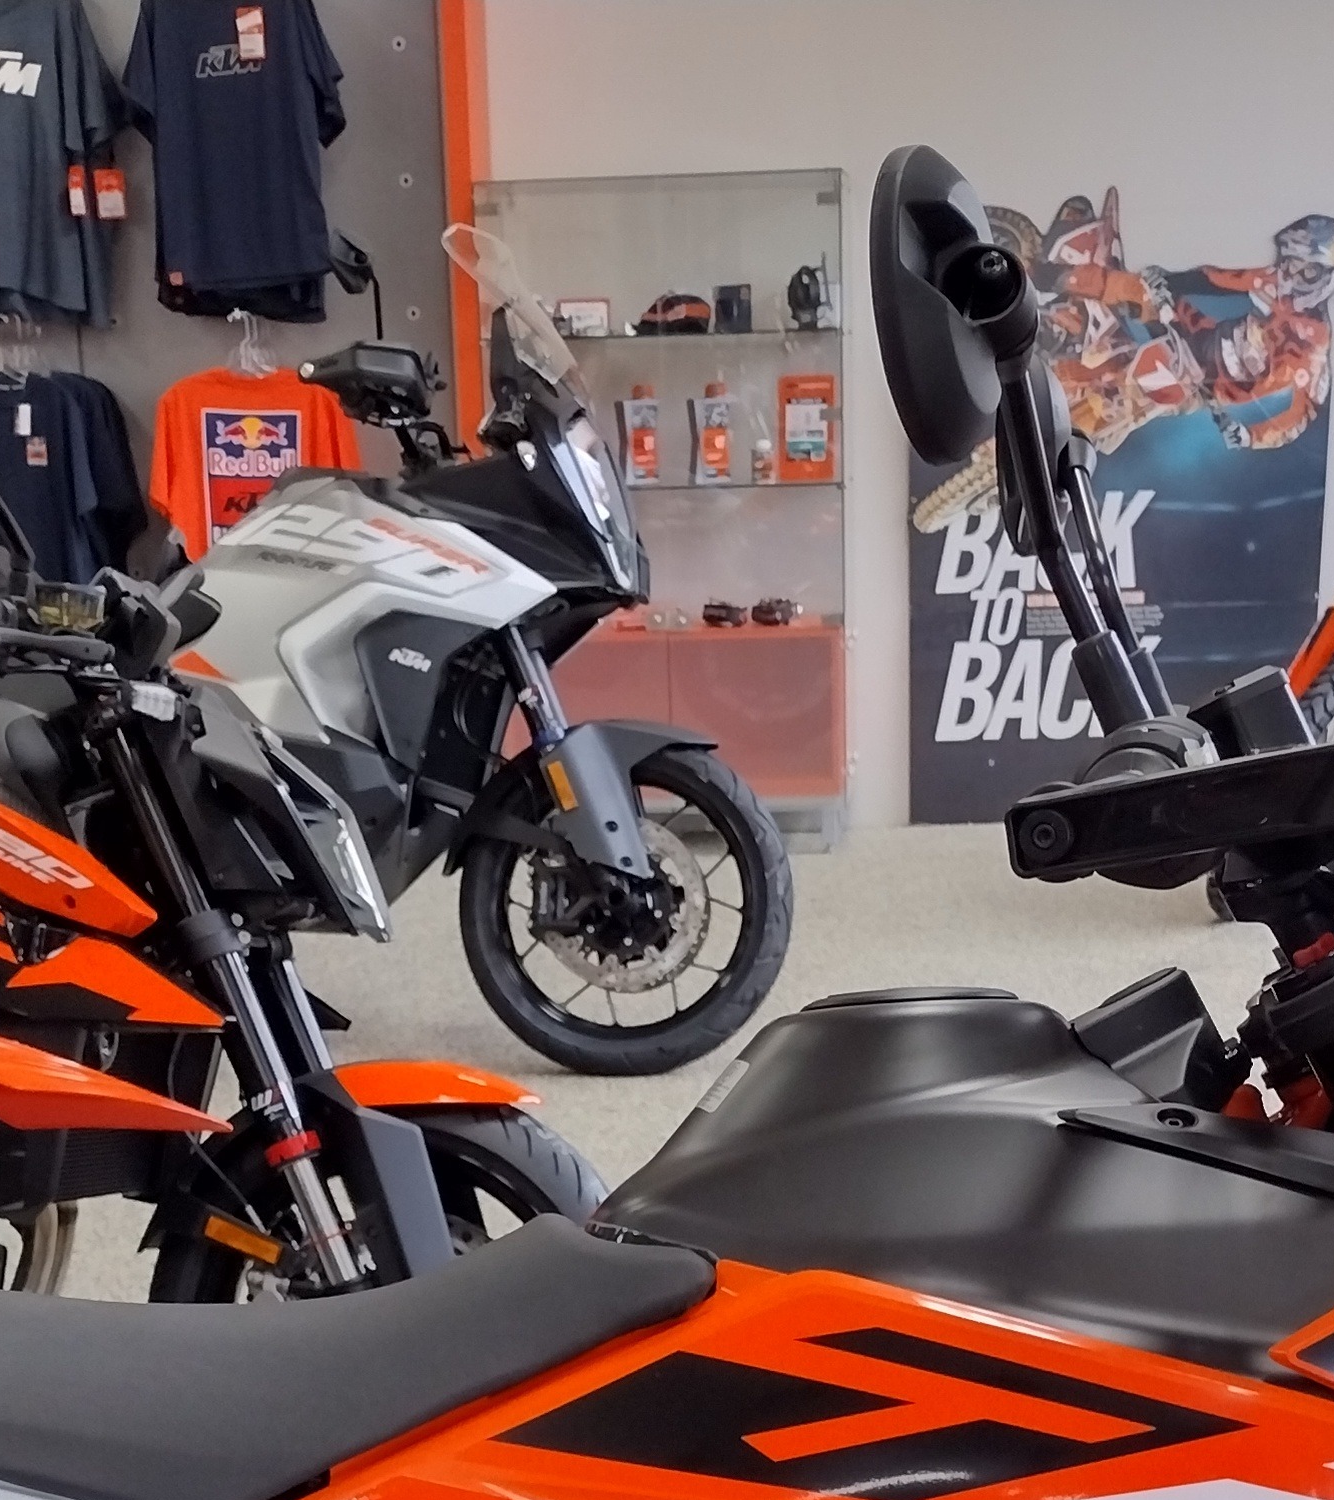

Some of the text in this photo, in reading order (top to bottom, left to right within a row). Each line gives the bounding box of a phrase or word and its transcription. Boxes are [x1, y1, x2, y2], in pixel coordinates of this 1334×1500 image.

[208, 448, 296, 477] Red Bull
[970, 587, 1025, 646] TO
[388, 647, 433, 673] KTM
